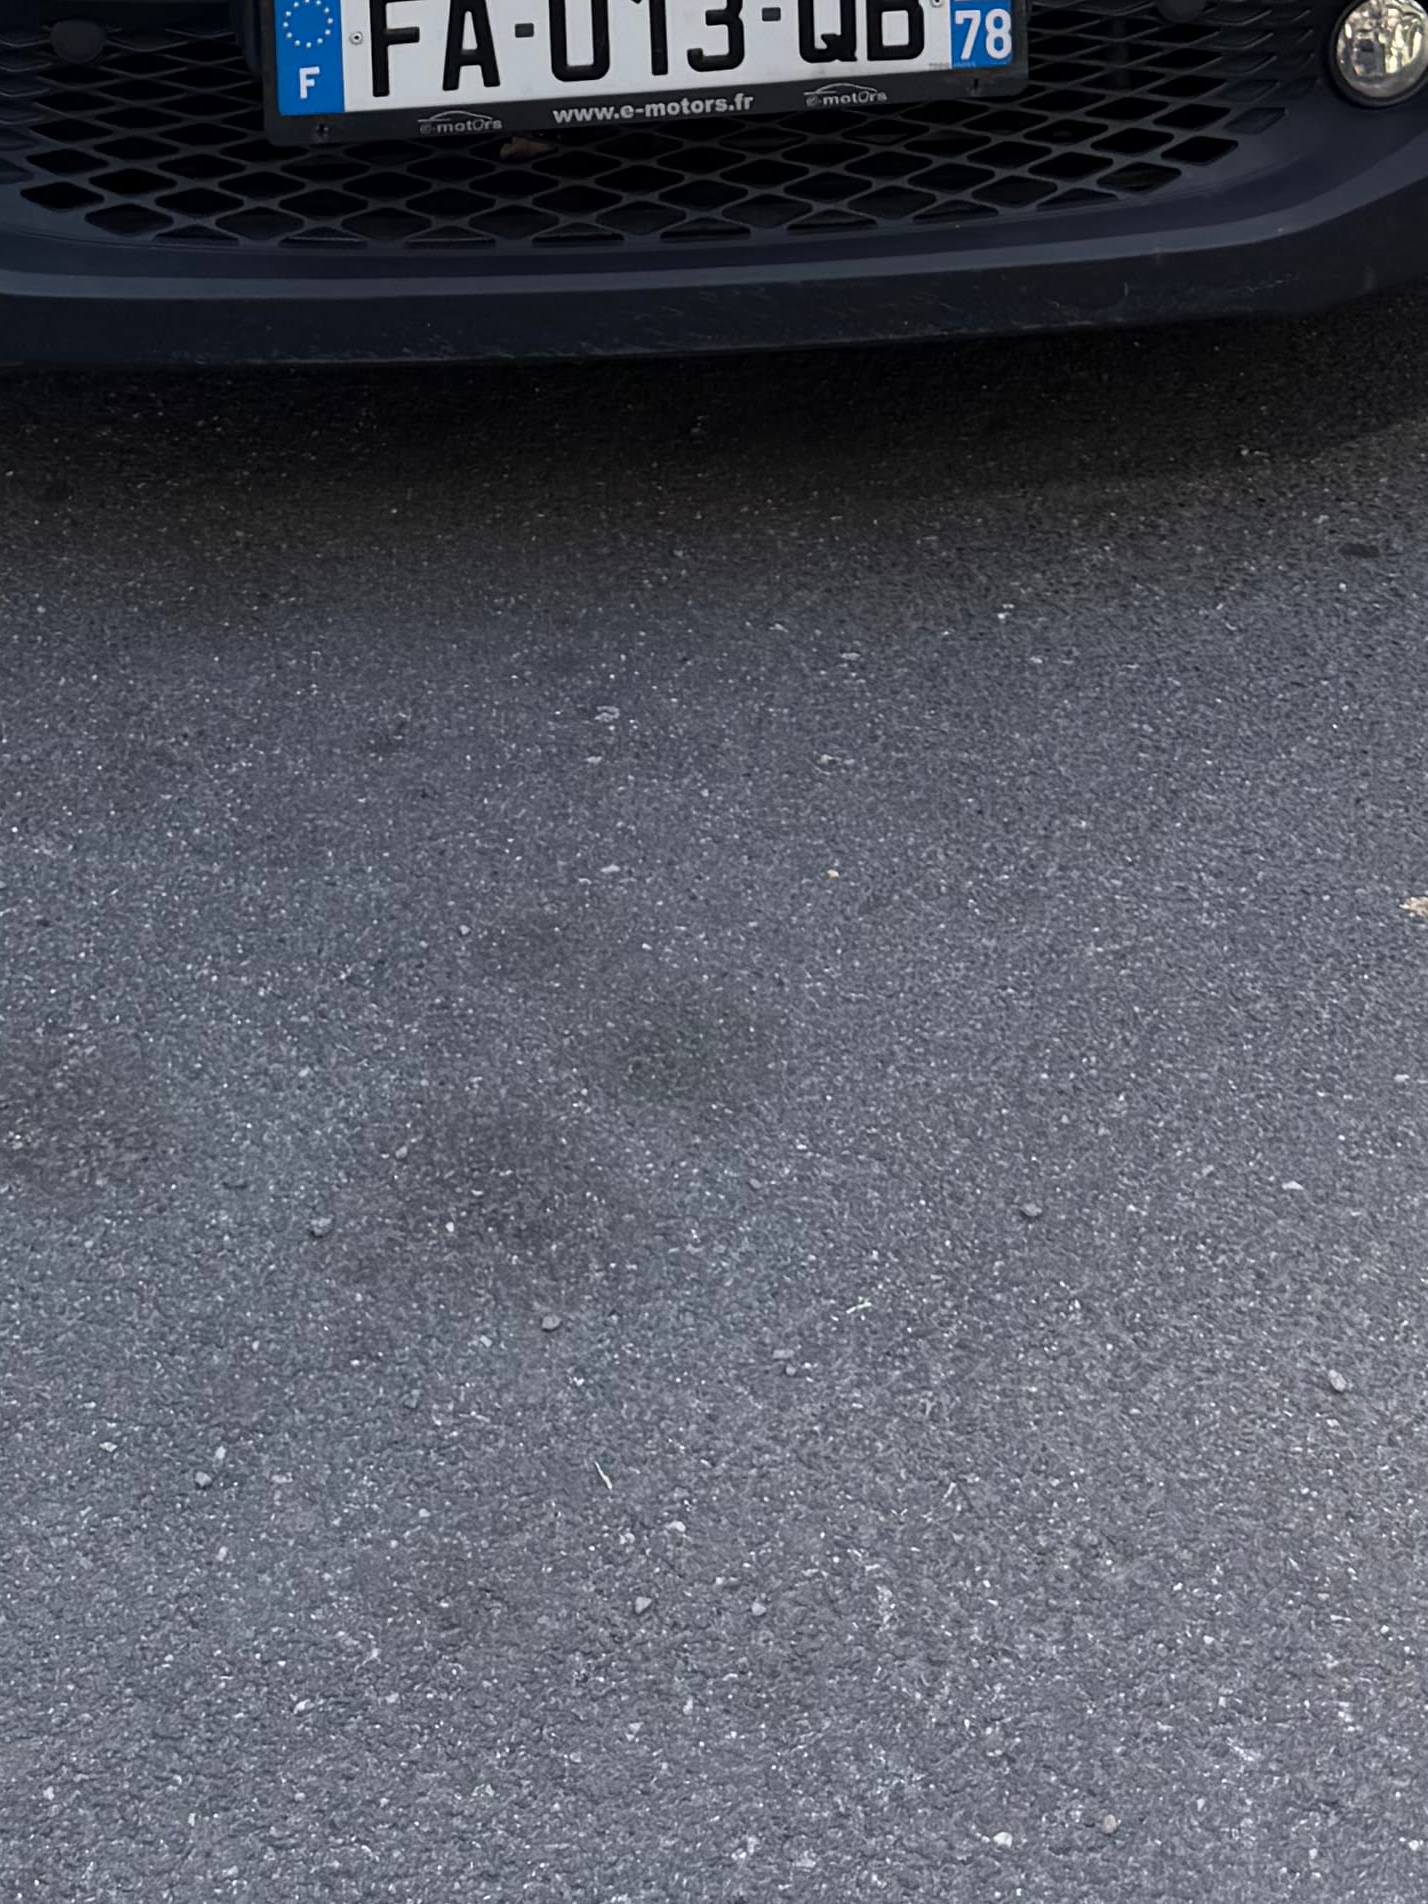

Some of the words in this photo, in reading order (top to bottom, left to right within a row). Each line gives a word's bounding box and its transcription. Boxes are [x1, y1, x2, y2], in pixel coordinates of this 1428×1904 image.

[954, 8, 1013, 61] 78
[299, 65, 321, 99] F
[552, 93, 754, 124] www.e-motors.fr
